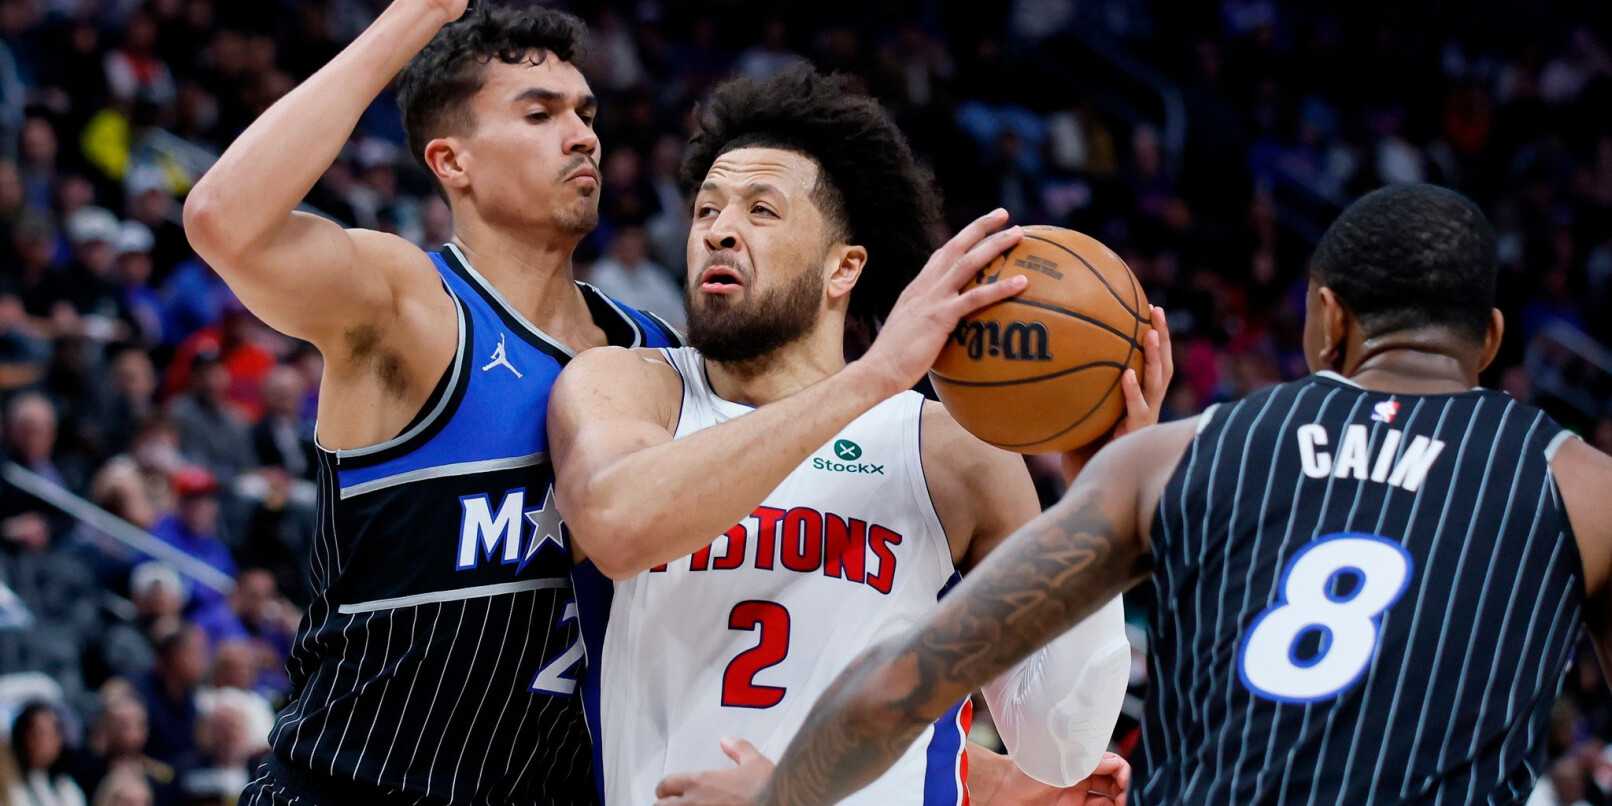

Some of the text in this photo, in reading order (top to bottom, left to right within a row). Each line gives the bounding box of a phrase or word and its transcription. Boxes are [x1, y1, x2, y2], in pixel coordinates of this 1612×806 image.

[812, 457, 885, 475] StockX
[1297, 423, 1446, 492] CAIN
[649, 505, 903, 595] STONS
[720, 599, 791, 710] 2
[1238, 531, 1415, 705] 8
